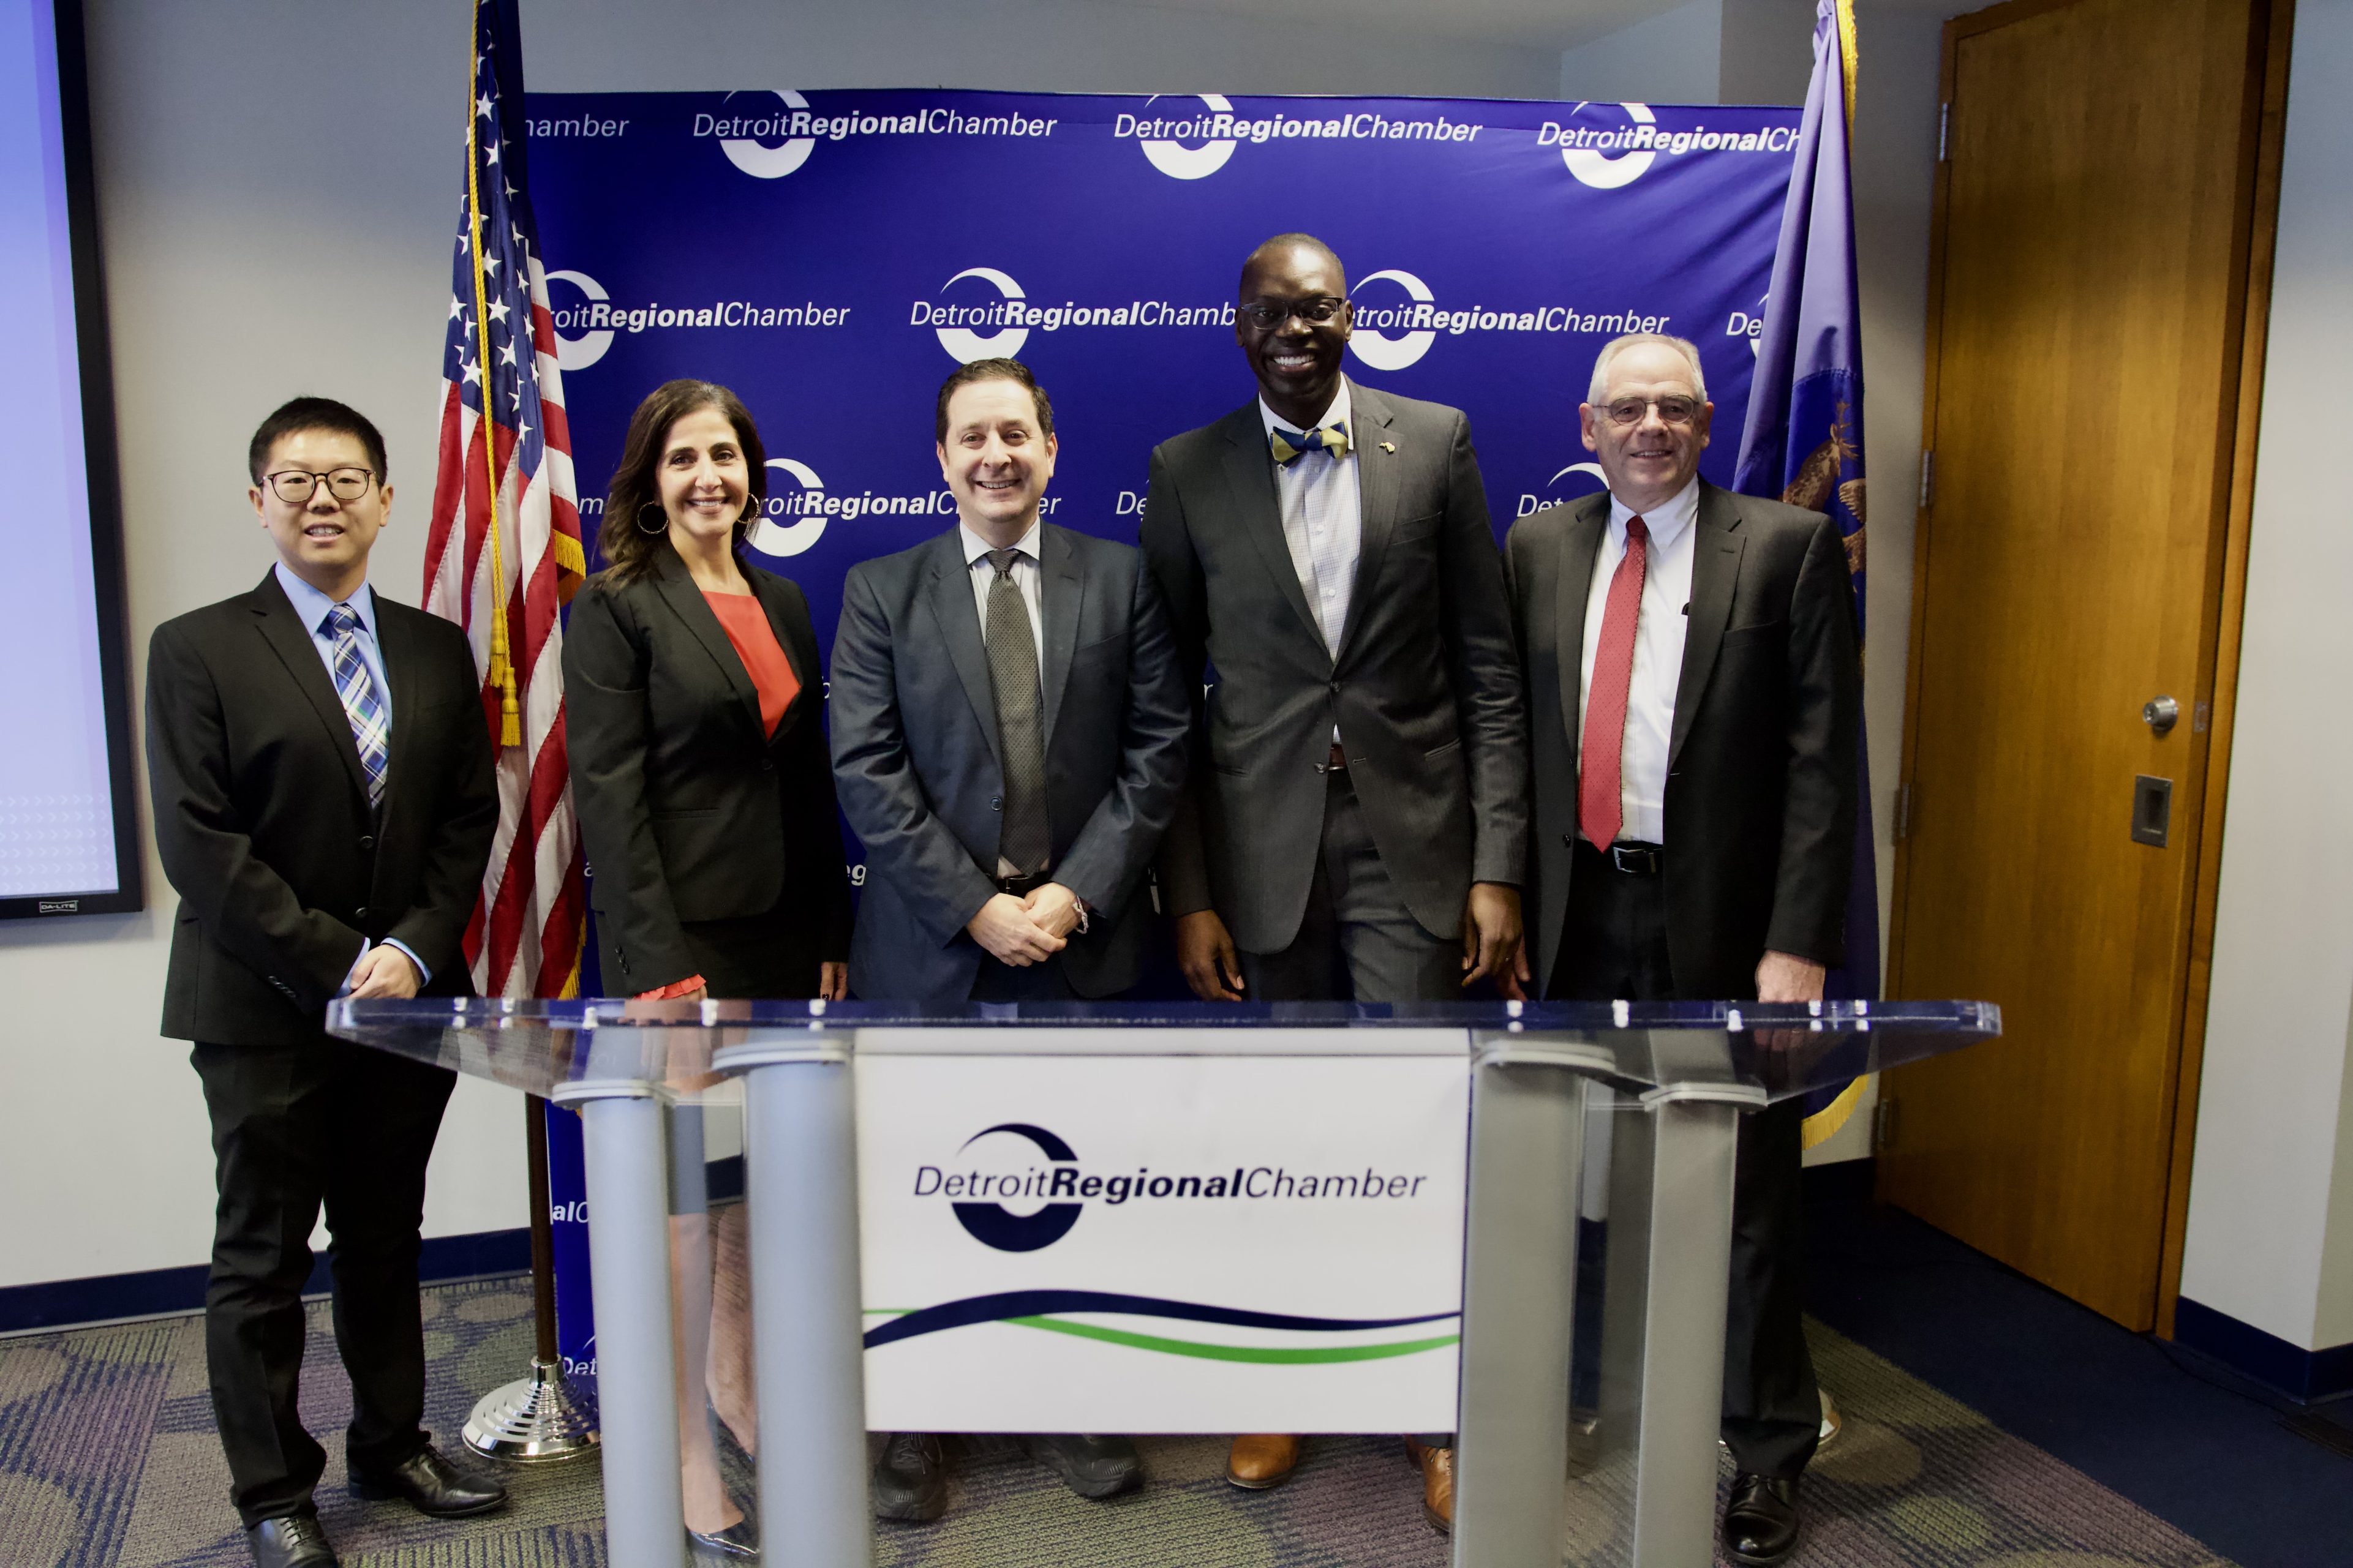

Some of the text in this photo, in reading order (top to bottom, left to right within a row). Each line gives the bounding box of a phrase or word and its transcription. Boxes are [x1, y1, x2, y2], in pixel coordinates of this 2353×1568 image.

[693, 109, 1058, 140] DetroitRegionalChamber
[1114, 113, 1483, 143] DetroitRegionalChamber
[1352, 304, 1670, 335] troitRegionalChamber
[914, 1166, 1427, 1204] DetroitRegionalChamber
